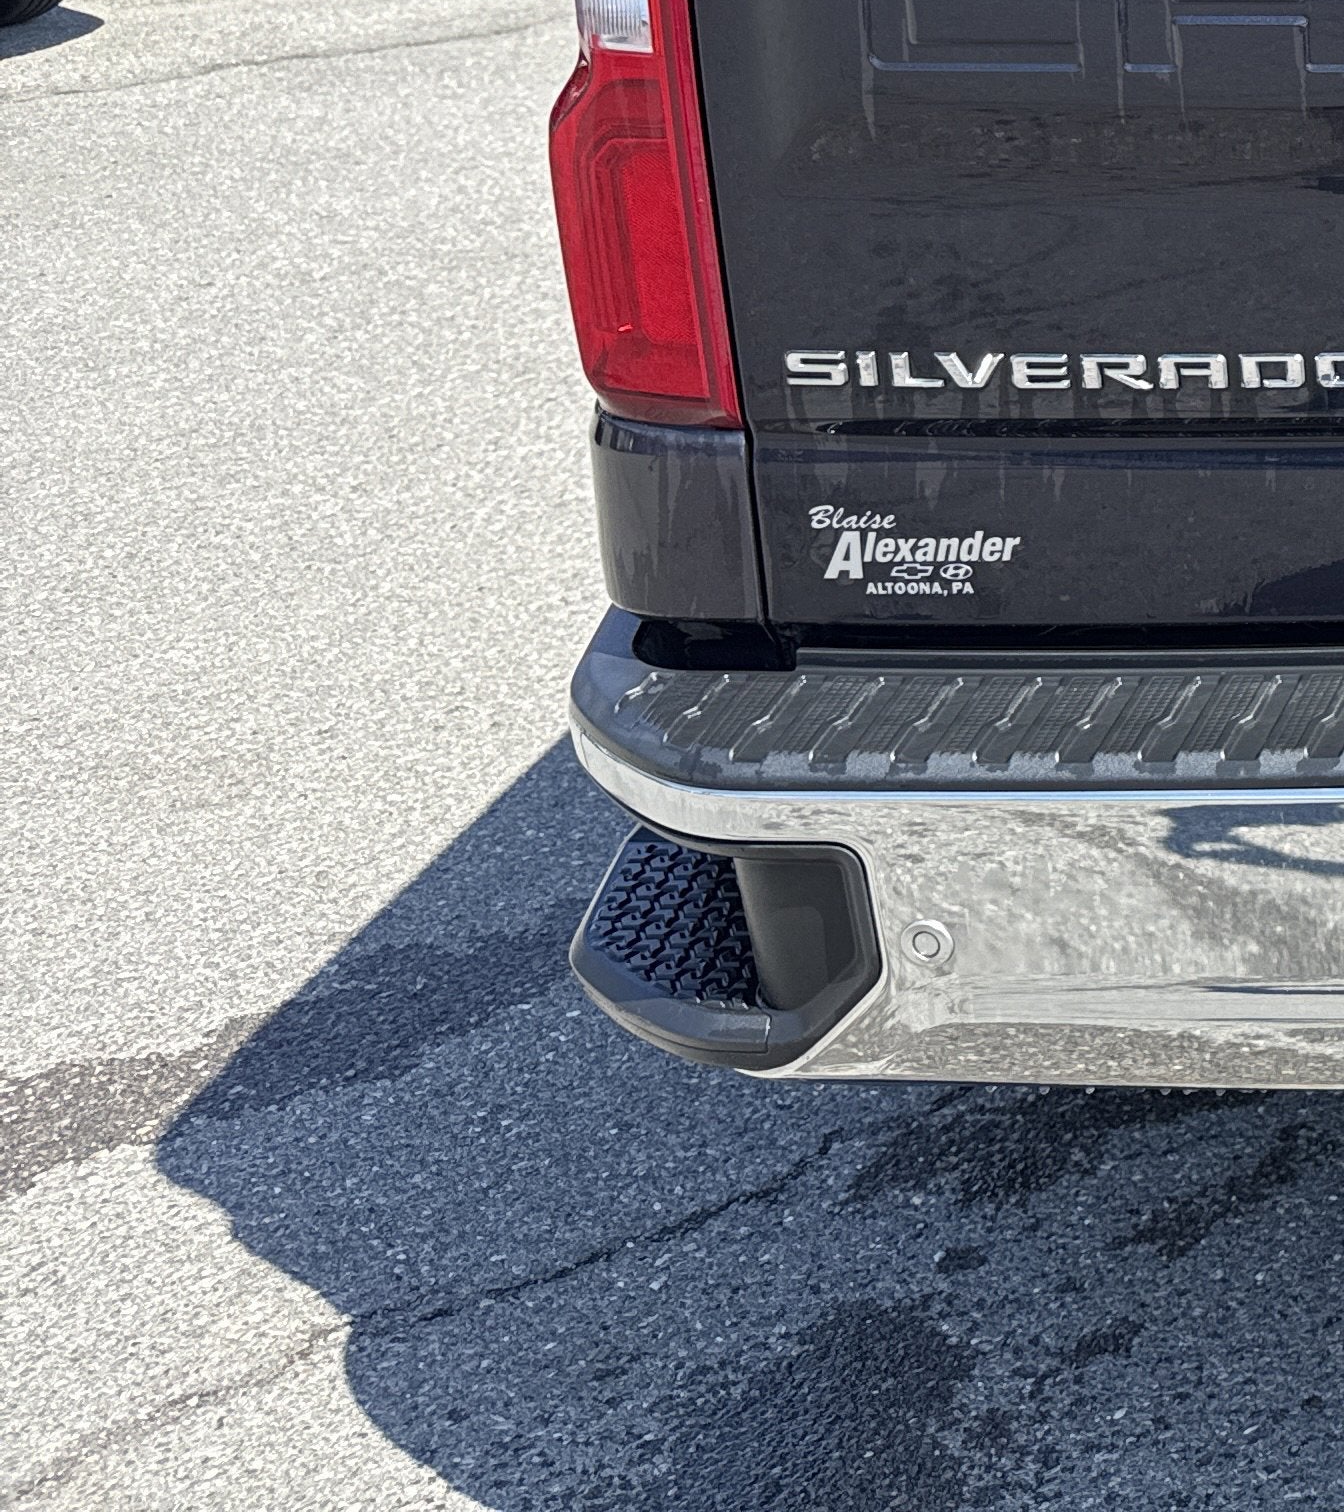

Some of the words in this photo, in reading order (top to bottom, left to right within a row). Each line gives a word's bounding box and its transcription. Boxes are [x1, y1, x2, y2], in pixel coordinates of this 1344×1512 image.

[808, 504, 897, 530] Blaise
[823, 530, 1021, 580] Alexander
[865, 582, 949, 597] ALTOONA,
[951, 582, 974, 595] PA
